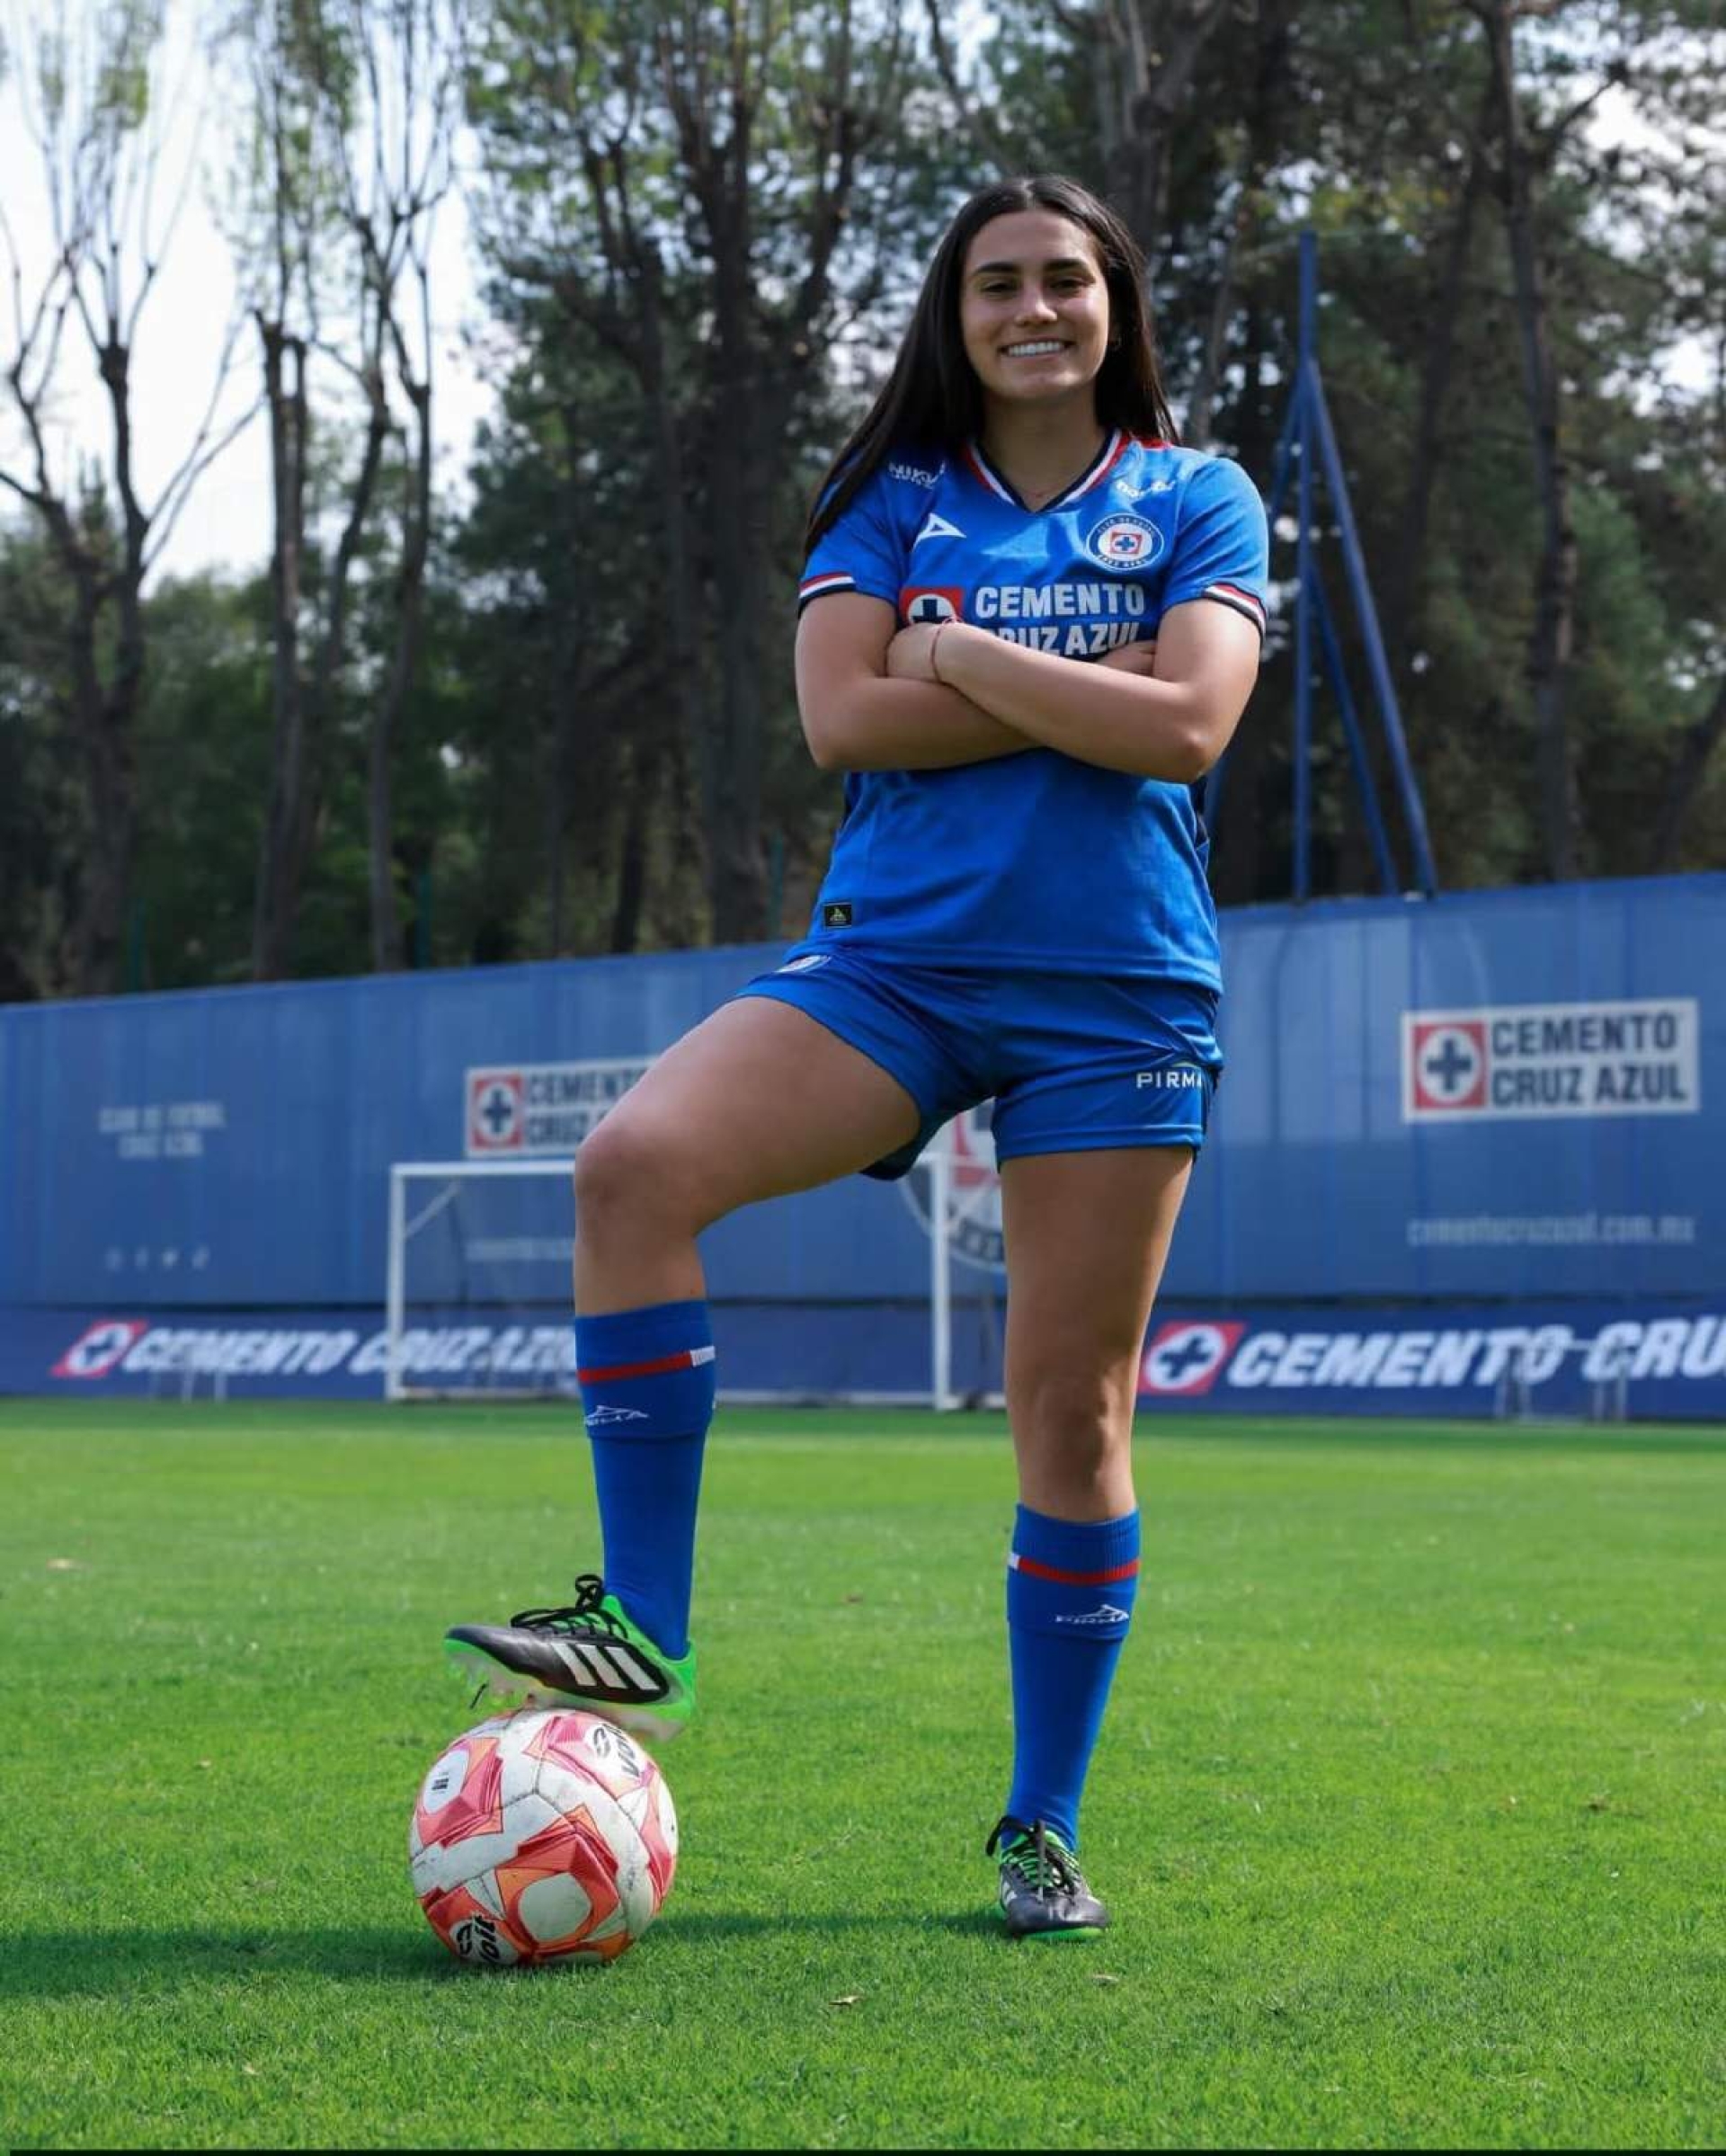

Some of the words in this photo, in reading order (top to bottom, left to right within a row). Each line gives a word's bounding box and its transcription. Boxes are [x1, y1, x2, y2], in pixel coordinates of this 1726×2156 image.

[975, 584, 1145, 619] CEMENTO
[1491, 1011, 1677, 1057] CEMENTO
[1491, 1067, 1583, 1107] CRUZ
[1595, 1064, 1686, 1102] AZUL
[123, 1329, 358, 1373] CEMENTO
[1227, 1325, 1573, 1387] CEMENTO
